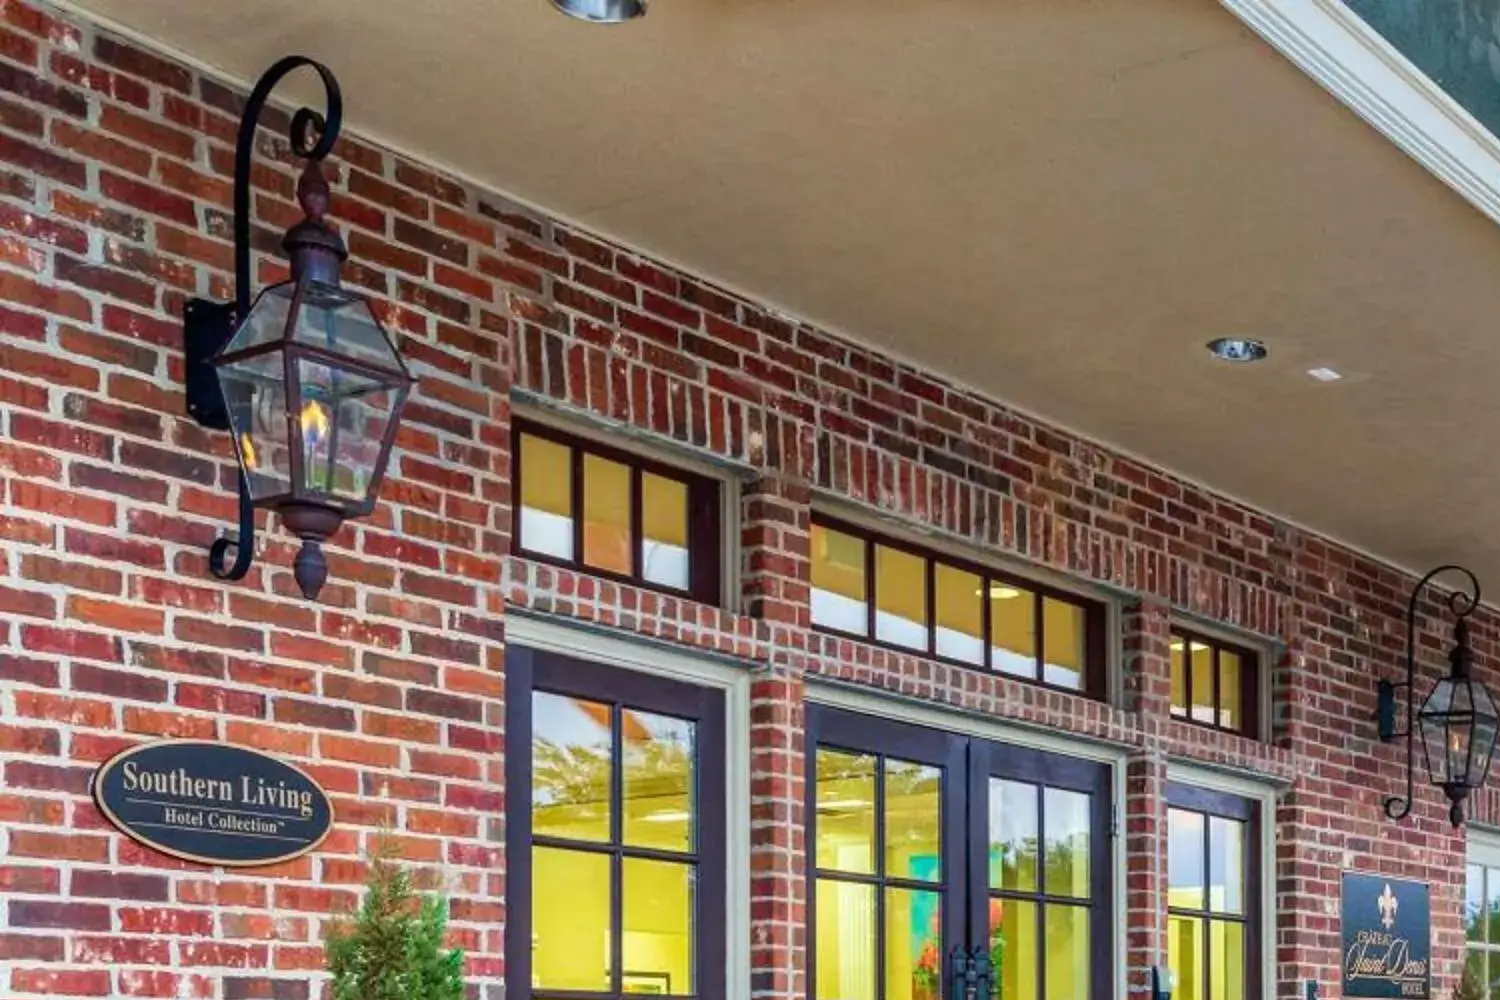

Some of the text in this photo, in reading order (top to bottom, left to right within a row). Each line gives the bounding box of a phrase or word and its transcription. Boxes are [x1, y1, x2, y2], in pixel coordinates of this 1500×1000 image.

[123, 761, 313, 817] Southern Living
[164, 807, 203, 828] Hotel
